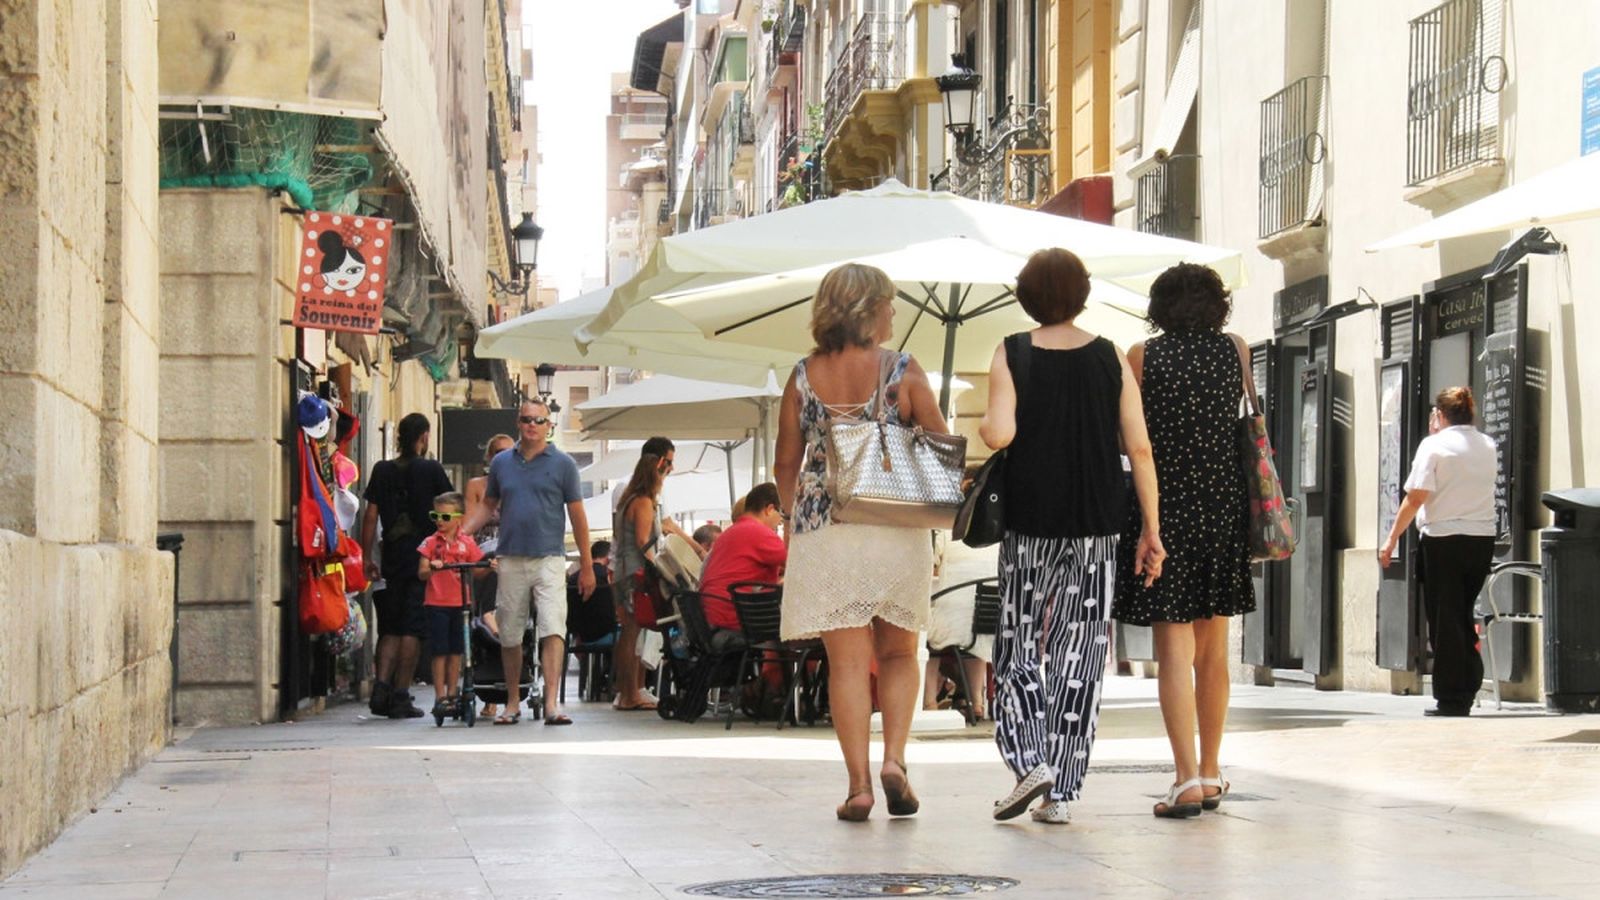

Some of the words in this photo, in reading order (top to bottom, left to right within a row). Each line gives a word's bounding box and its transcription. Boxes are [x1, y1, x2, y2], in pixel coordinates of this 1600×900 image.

[302, 296, 317, 305] La
[320, 300, 354, 309] reina
[357, 303, 378, 312] del
[1440, 299, 1466, 317] Casa
[300, 305, 376, 329] Souvenir
